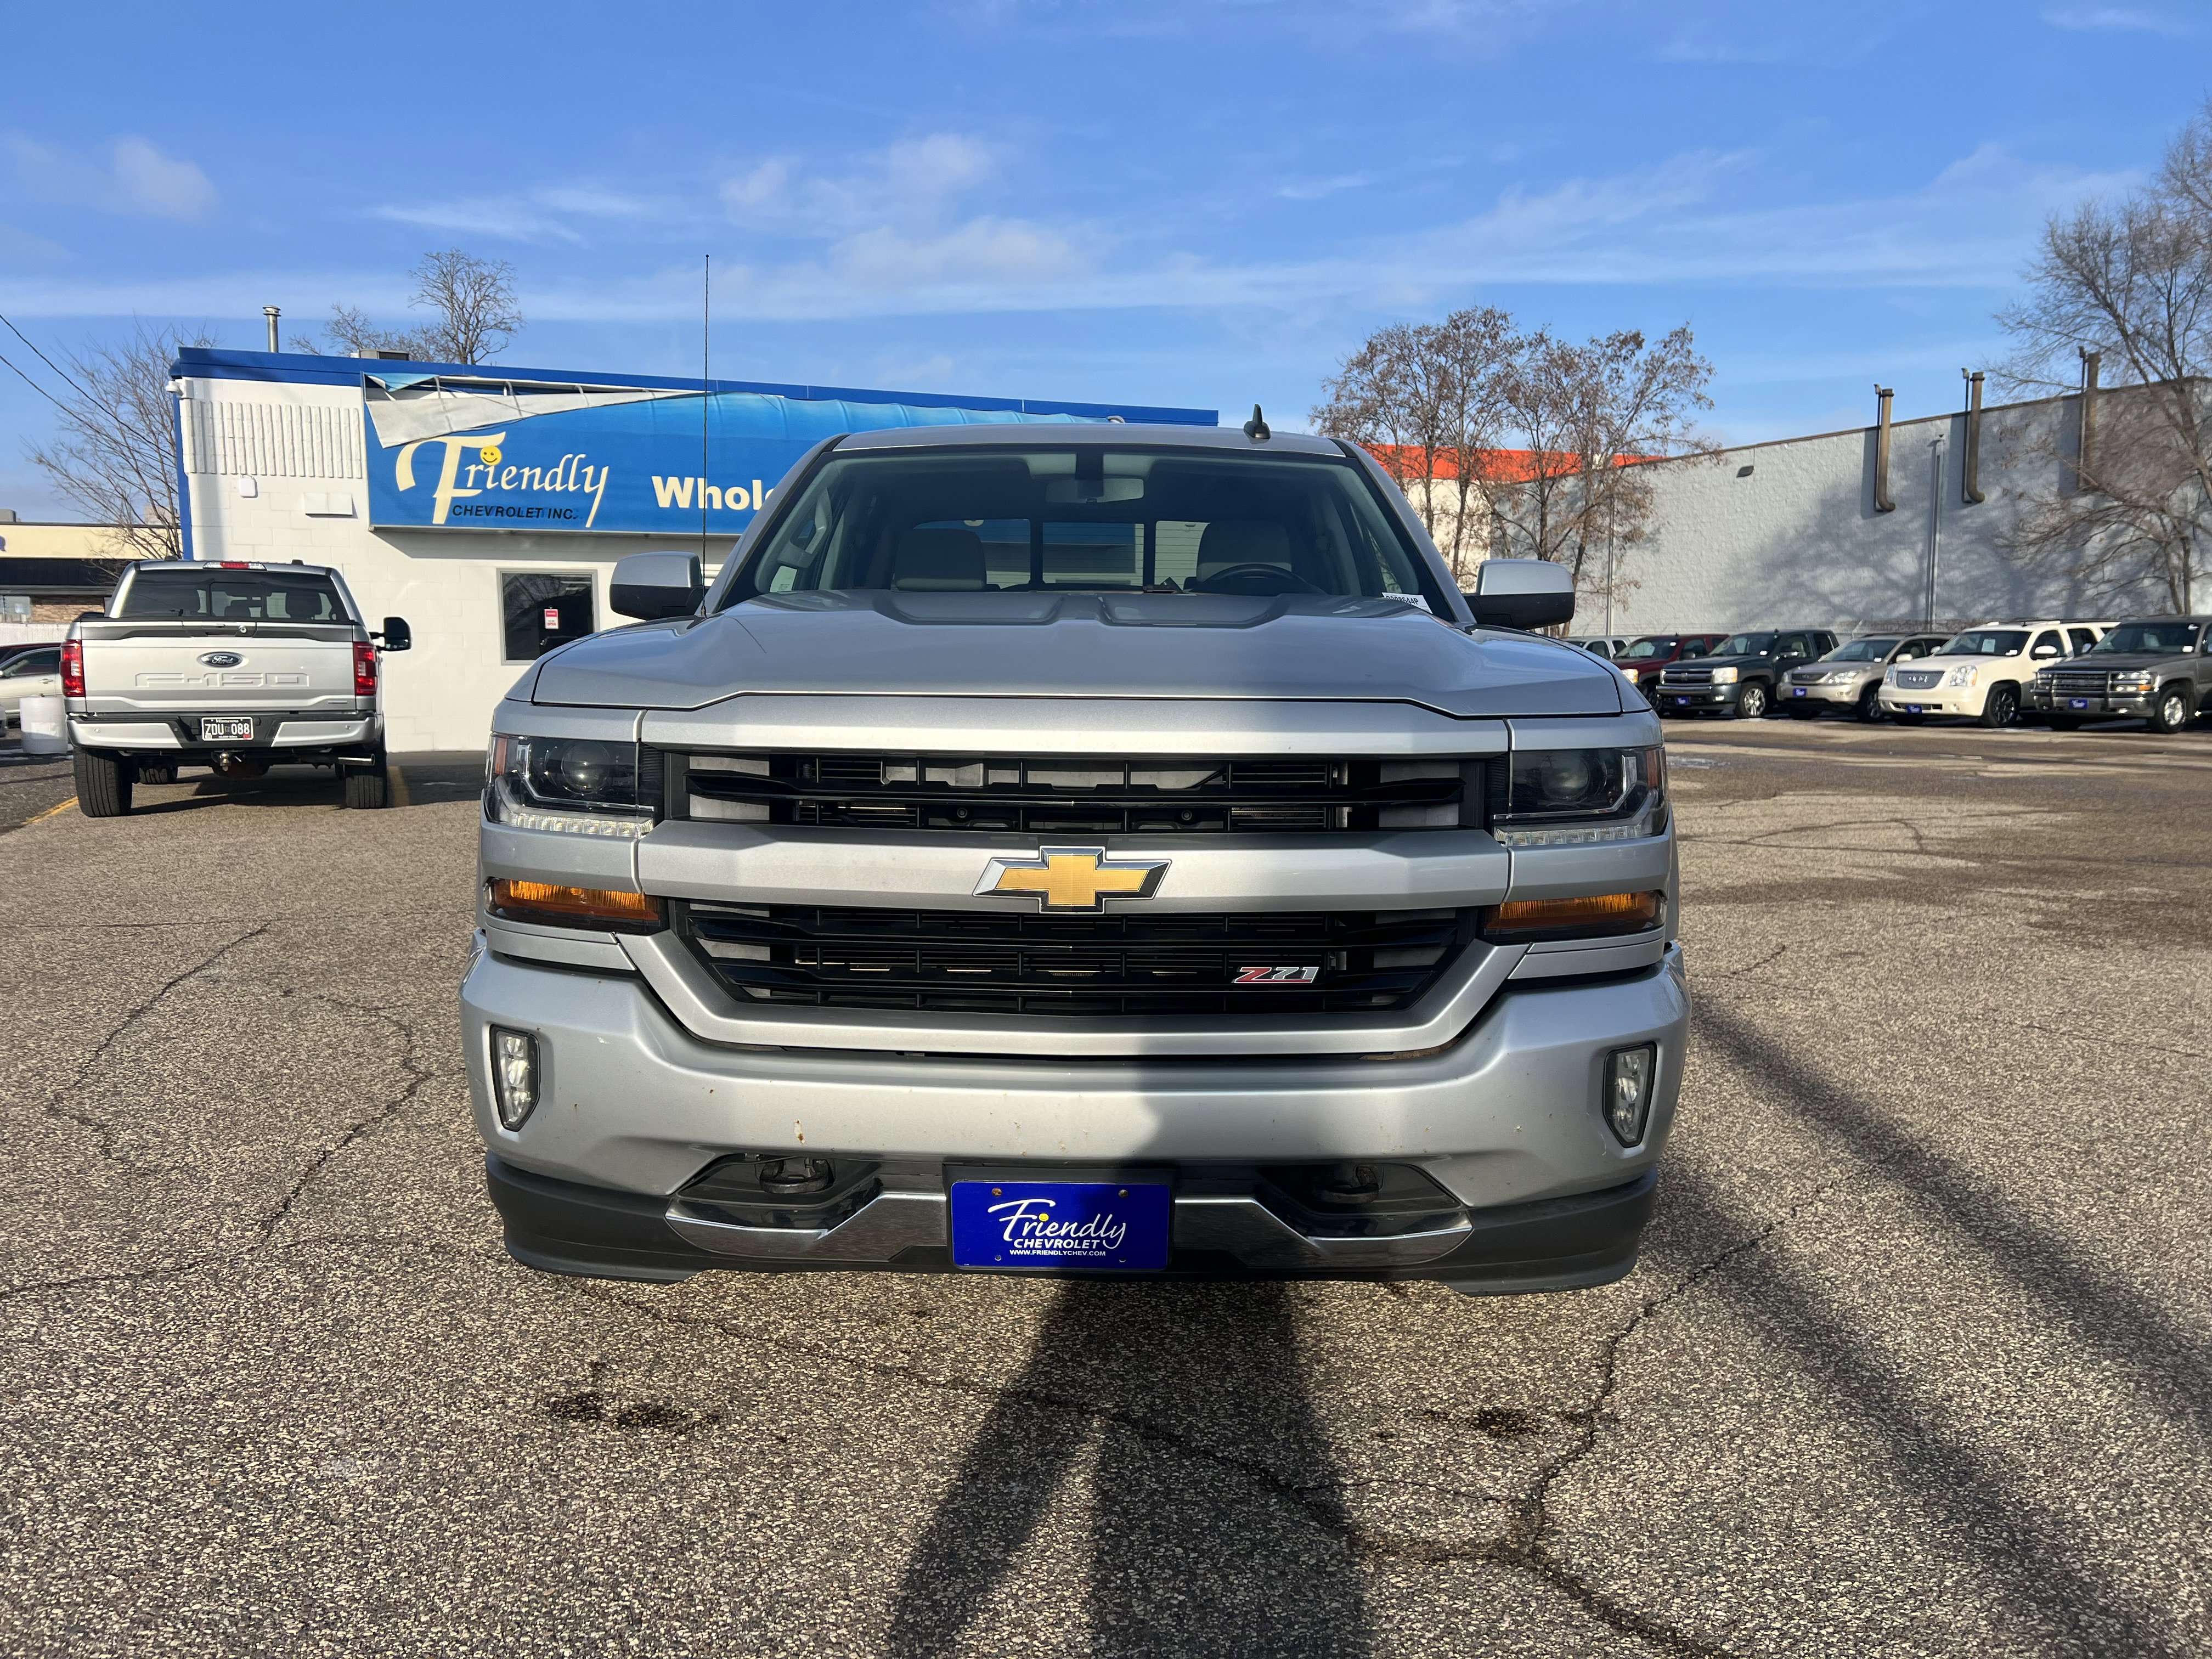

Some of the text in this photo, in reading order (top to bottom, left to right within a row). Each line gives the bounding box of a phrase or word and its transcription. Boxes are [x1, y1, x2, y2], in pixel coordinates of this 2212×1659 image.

[395, 432, 608, 528] Friendly
[651, 476, 775, 510] Whol
[452, 505, 577, 520] CHEVROLET INC.
[212, 655, 233, 664] Ford
[135, 673, 309, 687] F-150
[205, 723, 250, 735] ZDU 088
[1233, 966, 1319, 984] Z71
[988, 1199, 1126, 1249] Friendly
[1014, 1238, 1101, 1249] CHEVROLET
